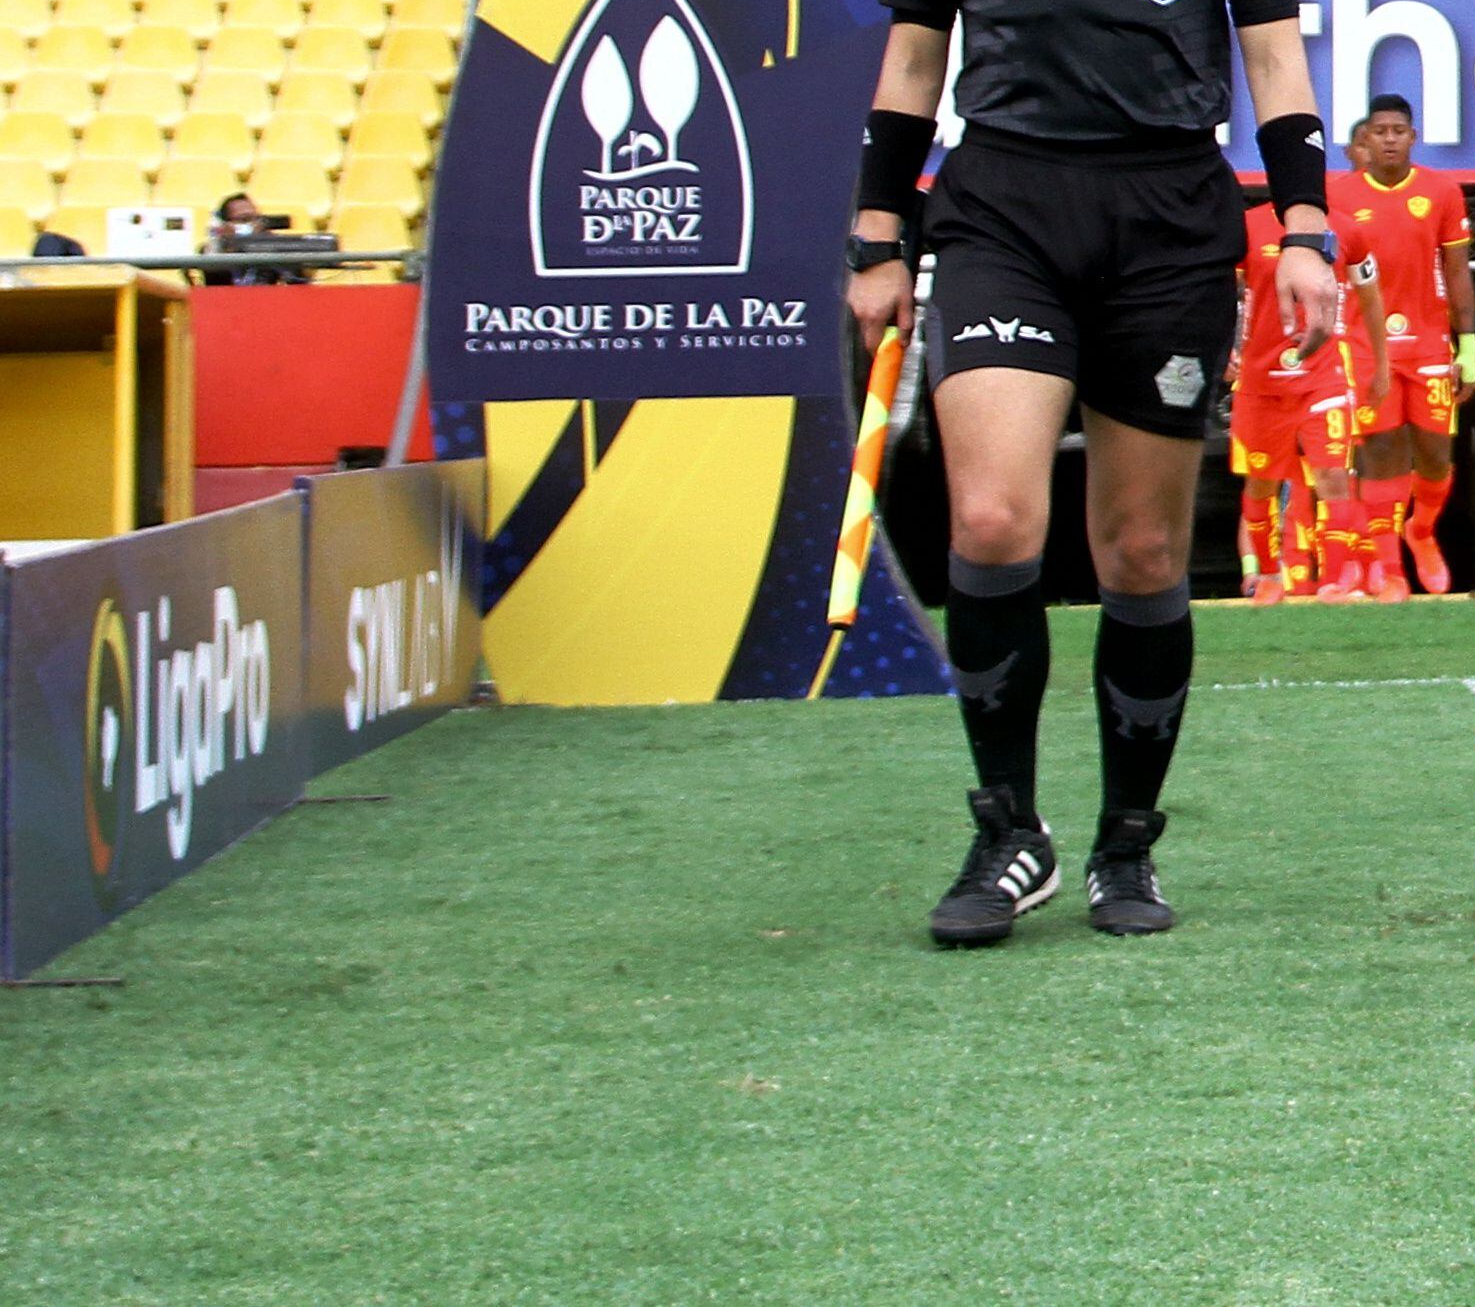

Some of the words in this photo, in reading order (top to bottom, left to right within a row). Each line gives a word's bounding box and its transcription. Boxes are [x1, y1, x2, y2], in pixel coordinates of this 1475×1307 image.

[579, 185, 702, 214] PARQUE
[631, 209, 702, 242] PAZ
[464, 303, 613, 338] PARQUE
[624, 303, 674, 331] DE
[685, 303, 731, 330] LA
[740, 298, 808, 329] PAZ
[464, 337, 643, 352] CAMPOSANTOS
[654, 337, 667, 349] Y
[679, 333, 807, 349] SERVICIOS
[135, 585, 273, 860] LigaPro
